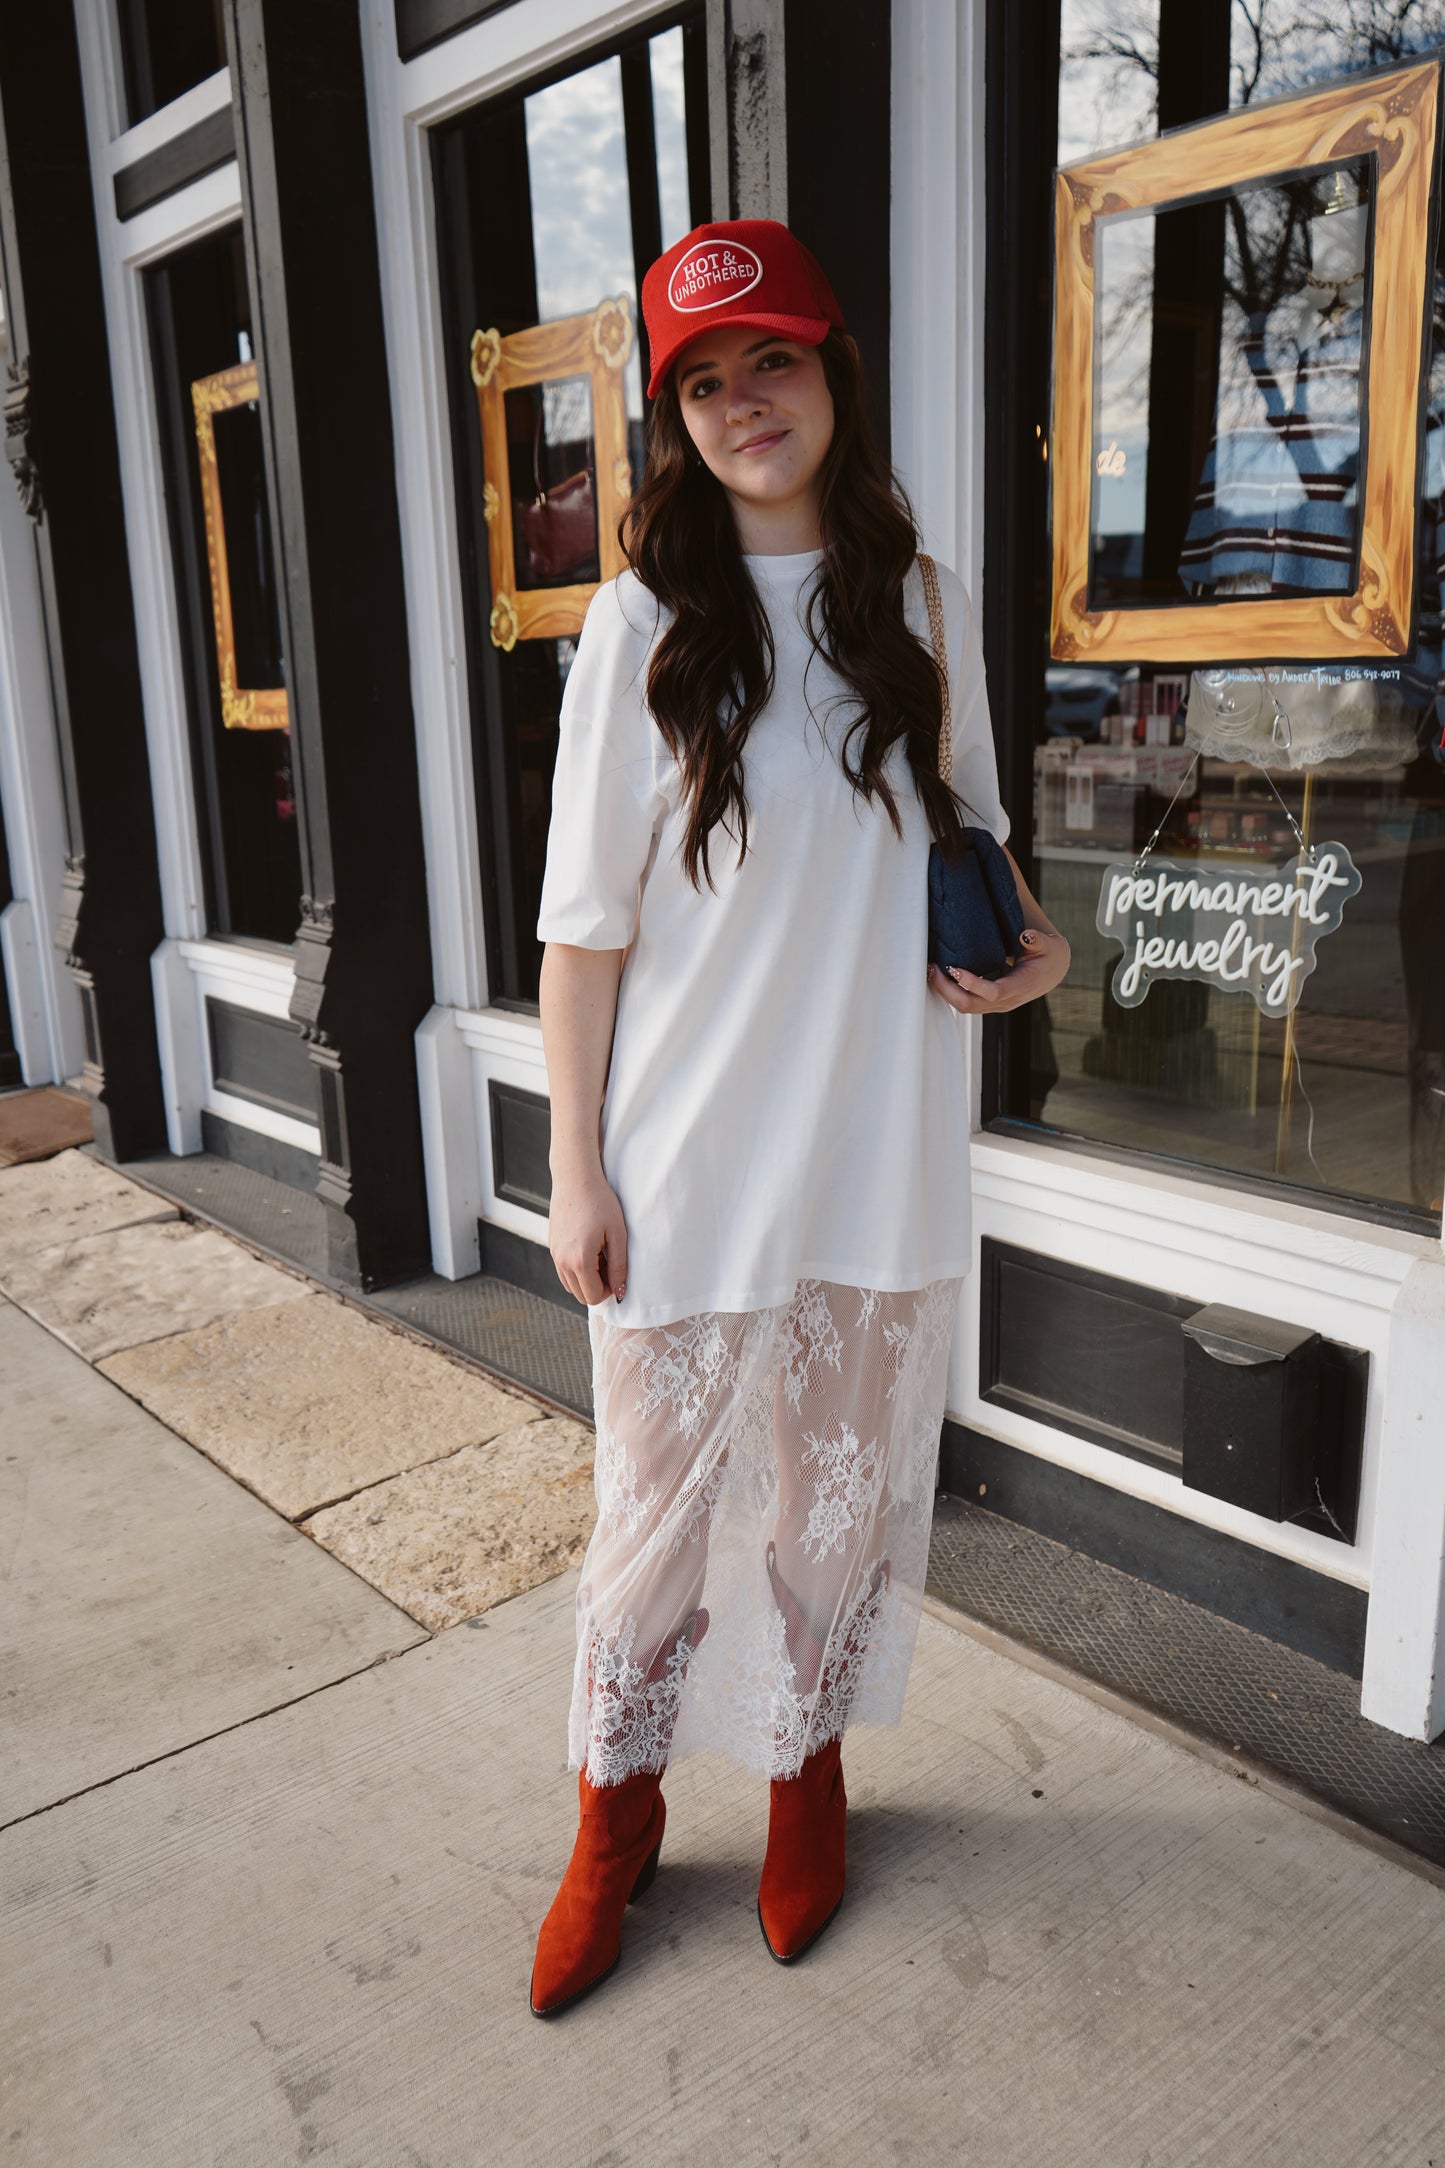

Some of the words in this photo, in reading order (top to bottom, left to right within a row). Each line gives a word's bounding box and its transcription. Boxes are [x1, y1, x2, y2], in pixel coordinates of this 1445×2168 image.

[674, 264, 755, 303] UNBOTHERED
[683, 253, 720, 282] HOT
[723, 250, 738, 266] &
[1311, 666, 1342, 692] TAYLOR
[1344, 668, 1362, 682] 806
[1105, 854, 1349, 926] permanent
[1120, 919, 1304, 1006] jewelry
